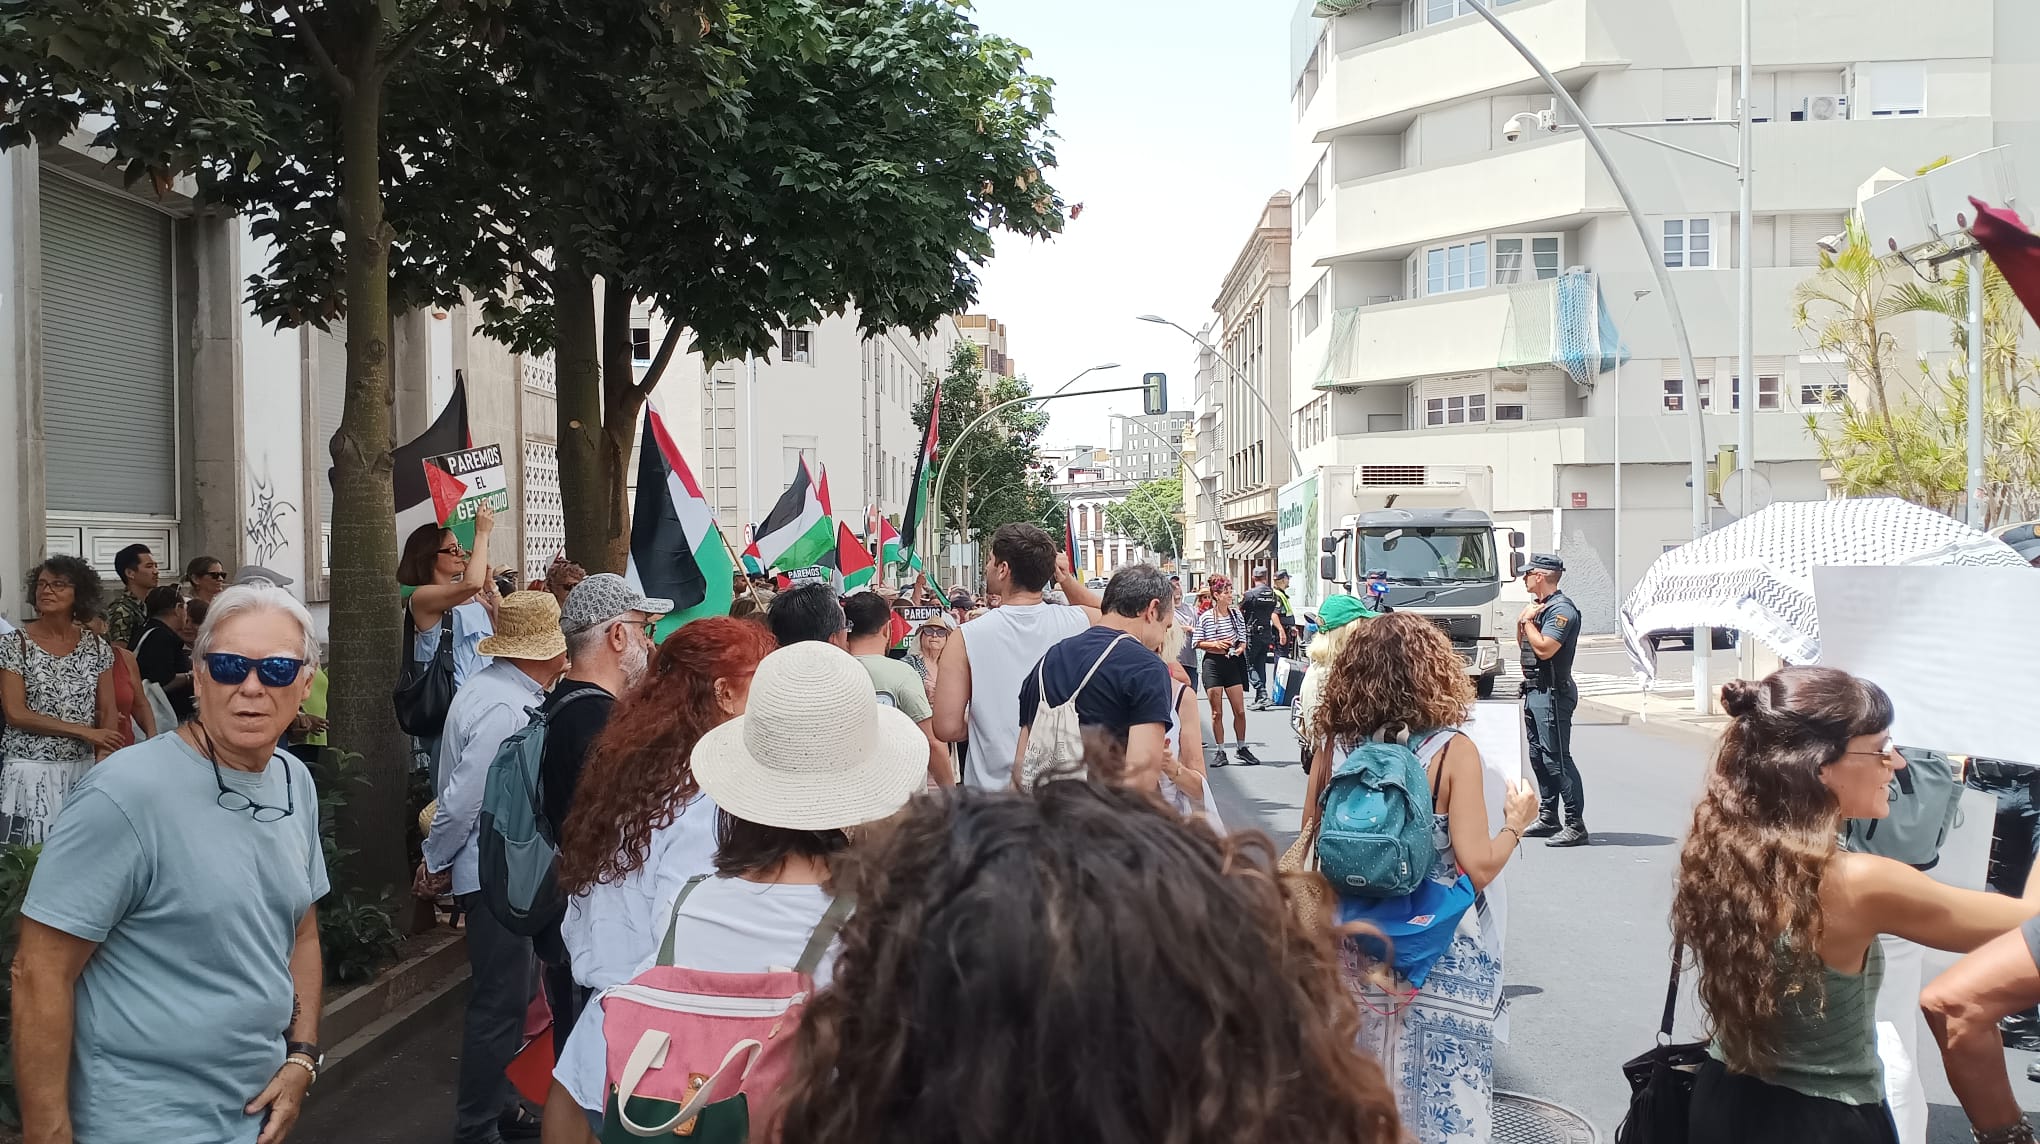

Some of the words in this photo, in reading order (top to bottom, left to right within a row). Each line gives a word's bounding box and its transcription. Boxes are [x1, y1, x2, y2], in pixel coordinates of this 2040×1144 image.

[447, 446, 500, 474] PAREMOS
[475, 475, 487, 490] EL
[788, 568, 820, 579] PAREMOS
[904, 608, 940, 620] PAREMOS
